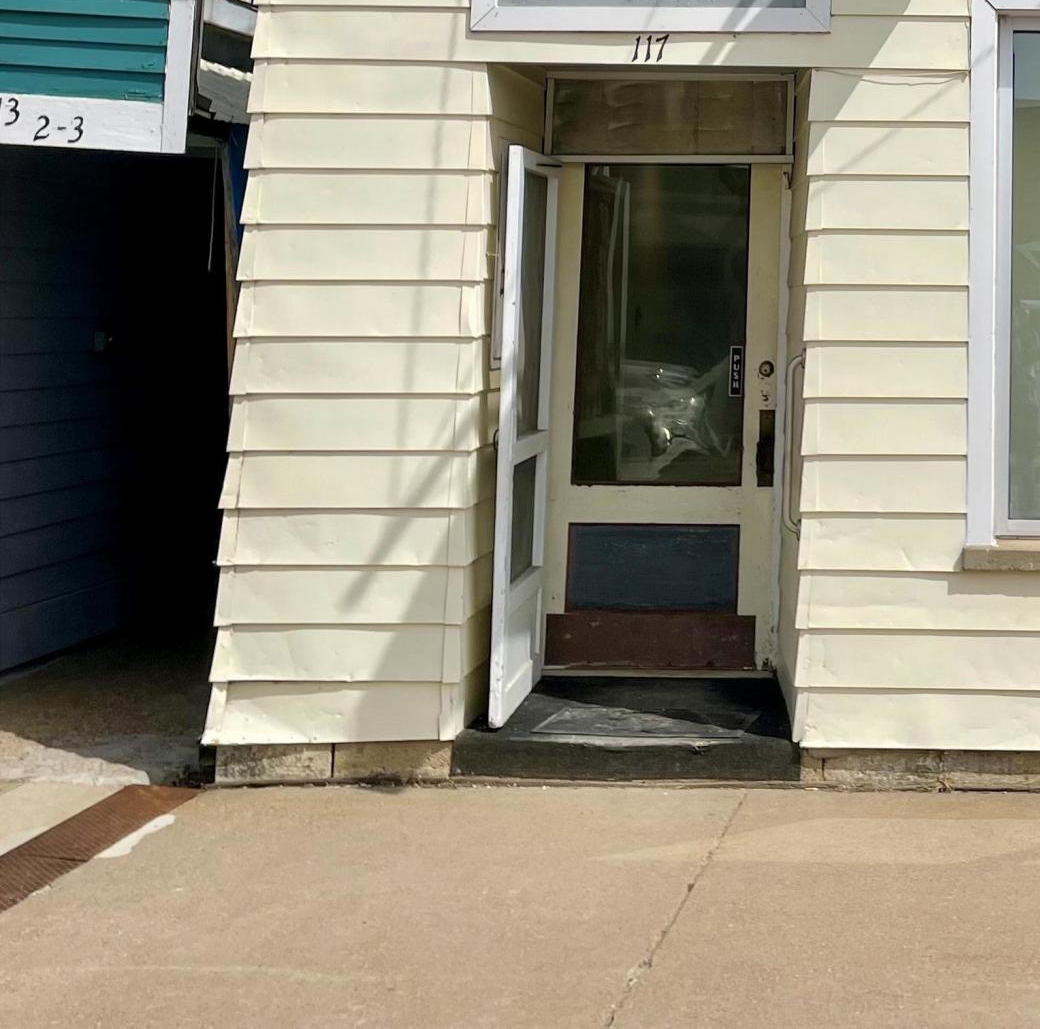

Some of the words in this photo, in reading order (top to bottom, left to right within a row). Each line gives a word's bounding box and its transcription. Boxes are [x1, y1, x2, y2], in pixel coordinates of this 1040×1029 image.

[631, 33, 671, 63] 117
[33, 115, 84, 143] 2-3
[732, 354, 741, 389] PUSH
